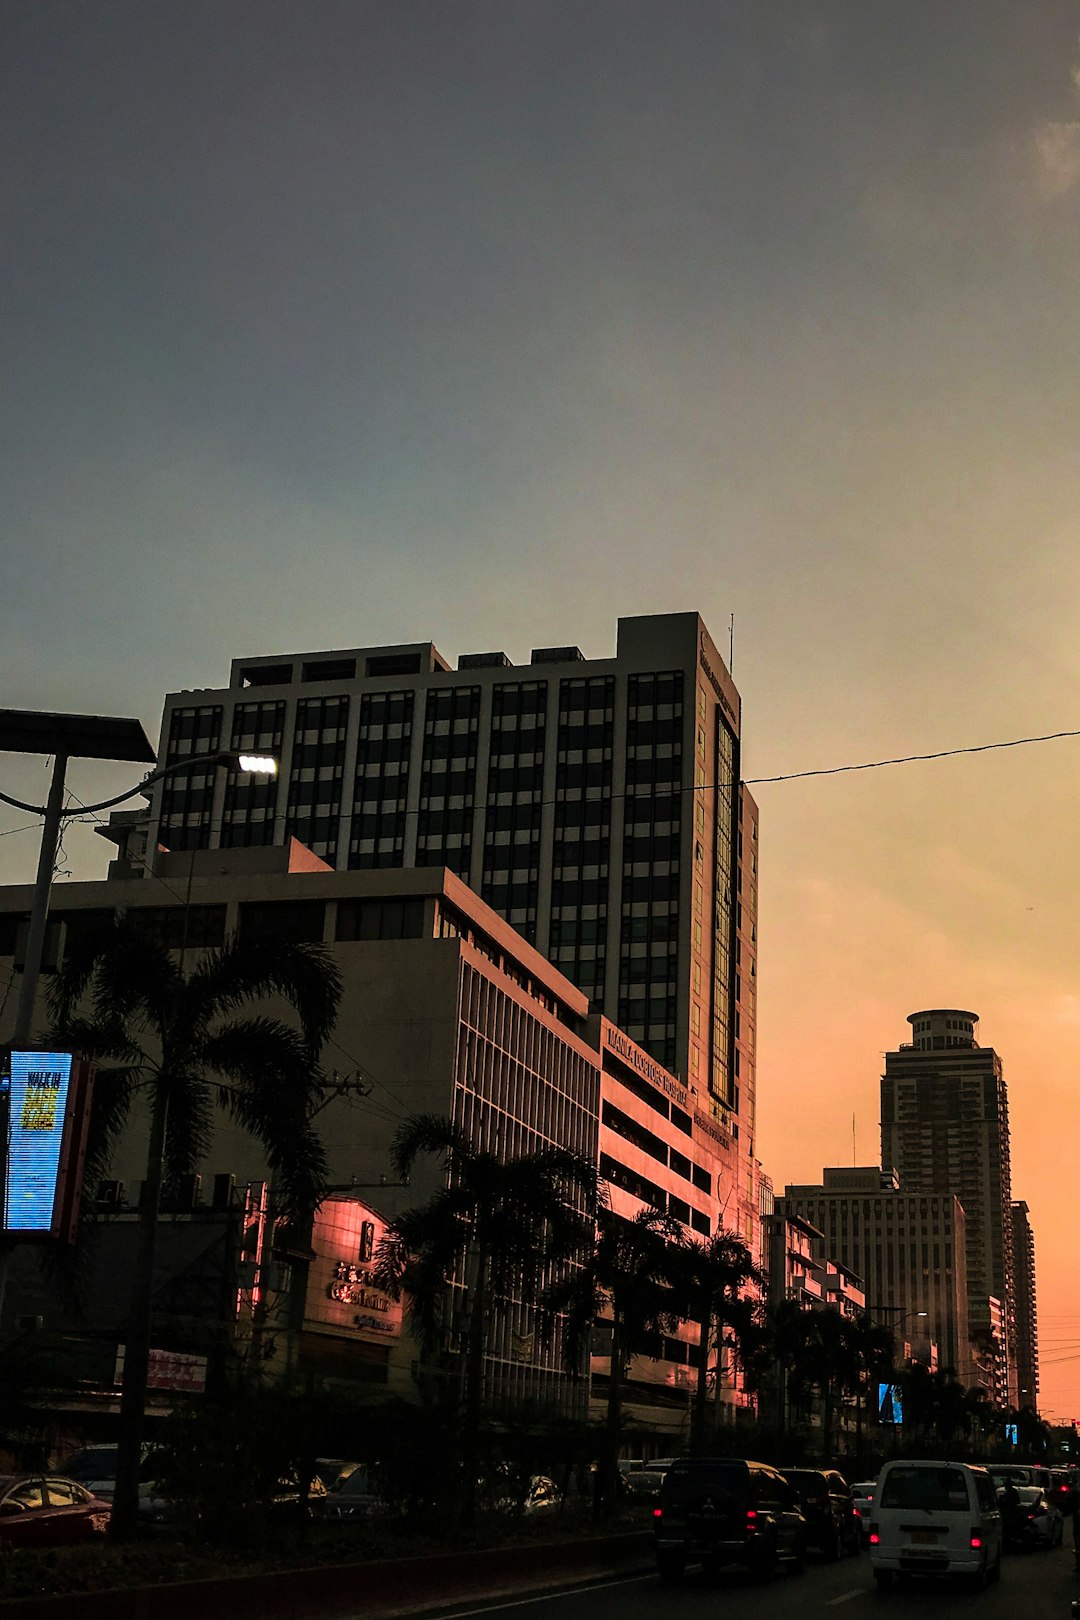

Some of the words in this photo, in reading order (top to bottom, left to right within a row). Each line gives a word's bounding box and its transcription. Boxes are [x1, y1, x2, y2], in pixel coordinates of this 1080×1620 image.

[608, 1029, 633, 1063] MANILA
[634, 1050, 663, 1086] DOCTORS
[663, 1075, 688, 1109] HOSPITAL
[688, 1512, 728, 1520] PAJERO
